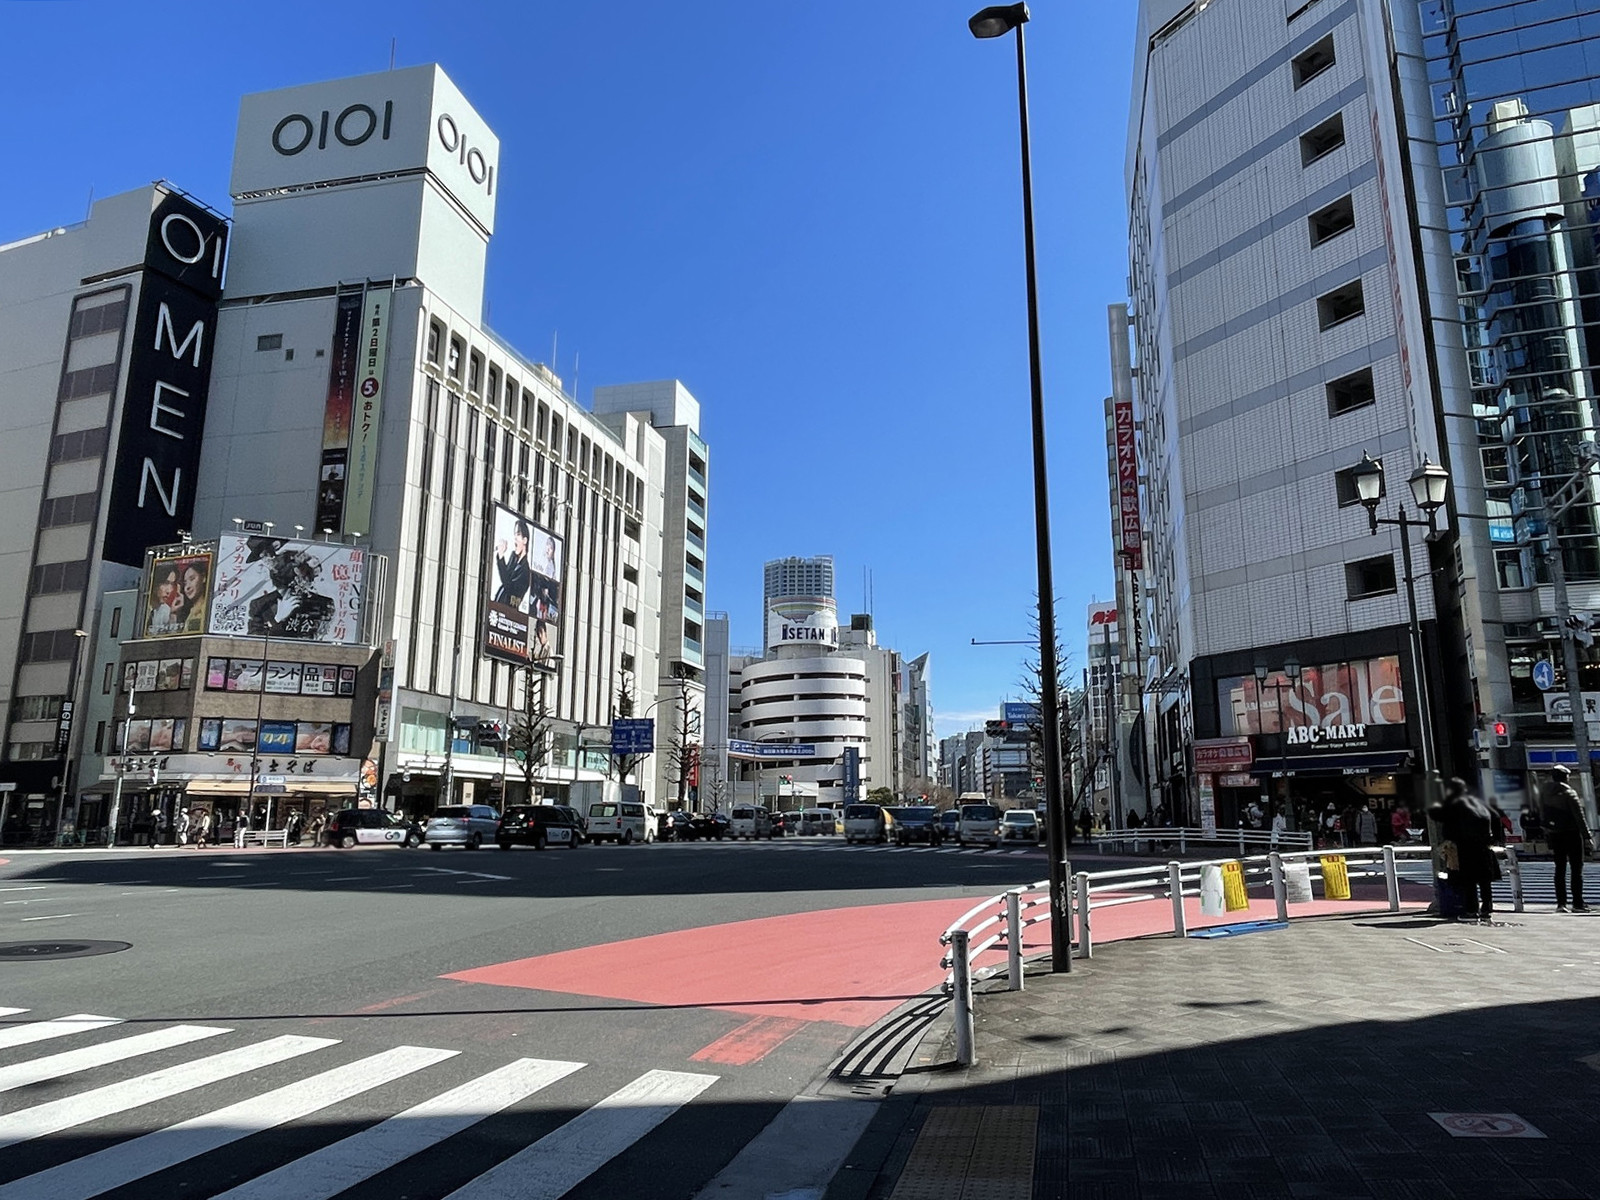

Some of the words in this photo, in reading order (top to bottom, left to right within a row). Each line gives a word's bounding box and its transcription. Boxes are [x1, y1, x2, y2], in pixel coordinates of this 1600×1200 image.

[137, 302, 205, 517] MEN
[488, 631, 526, 654] FINALIST
[781, 624, 825, 640] ISETAN
[1288, 663, 1406, 727] Sale
[1287, 723, 1366, 745] ABC-MART
[1368, 797, 1396, 810] B1F
